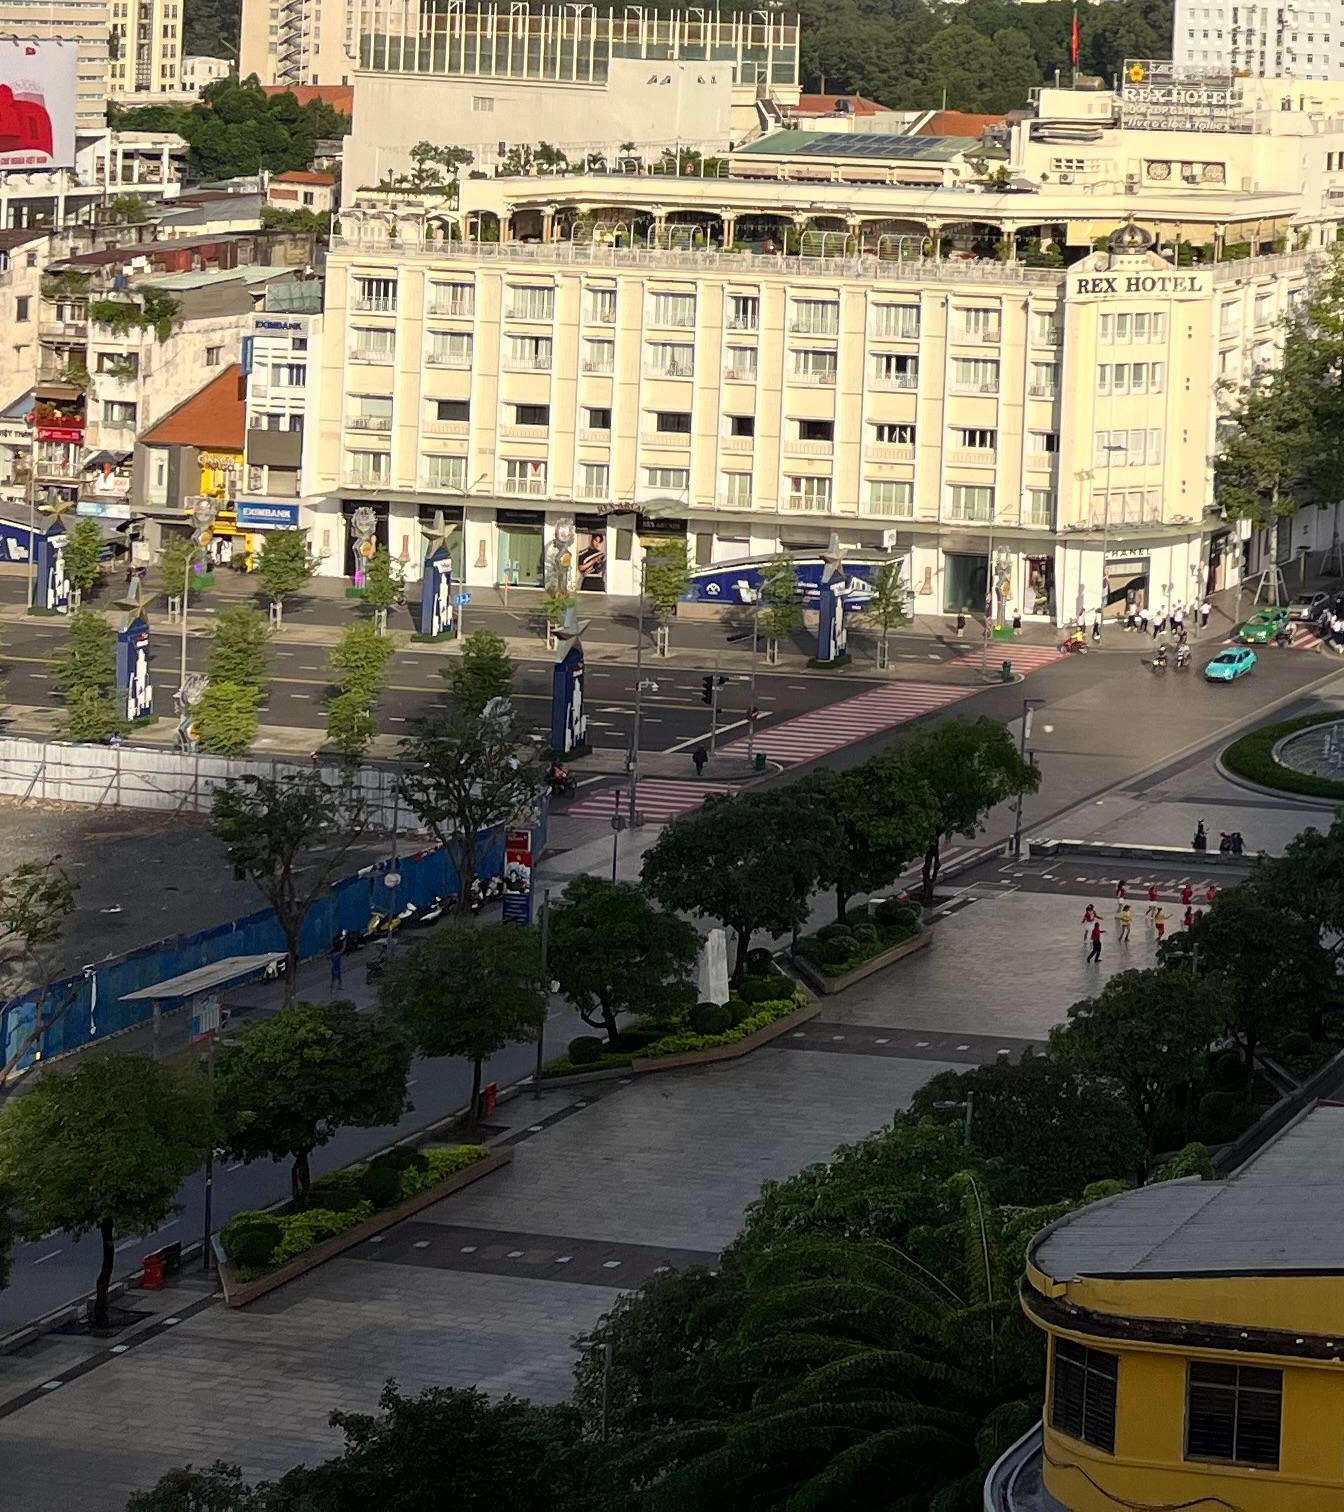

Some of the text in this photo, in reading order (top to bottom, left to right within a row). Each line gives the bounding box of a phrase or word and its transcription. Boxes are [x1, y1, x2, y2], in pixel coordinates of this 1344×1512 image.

[1124, 88, 1239, 105] REX HOTEL
[1077, 276, 1203, 294] REX HOTEL
